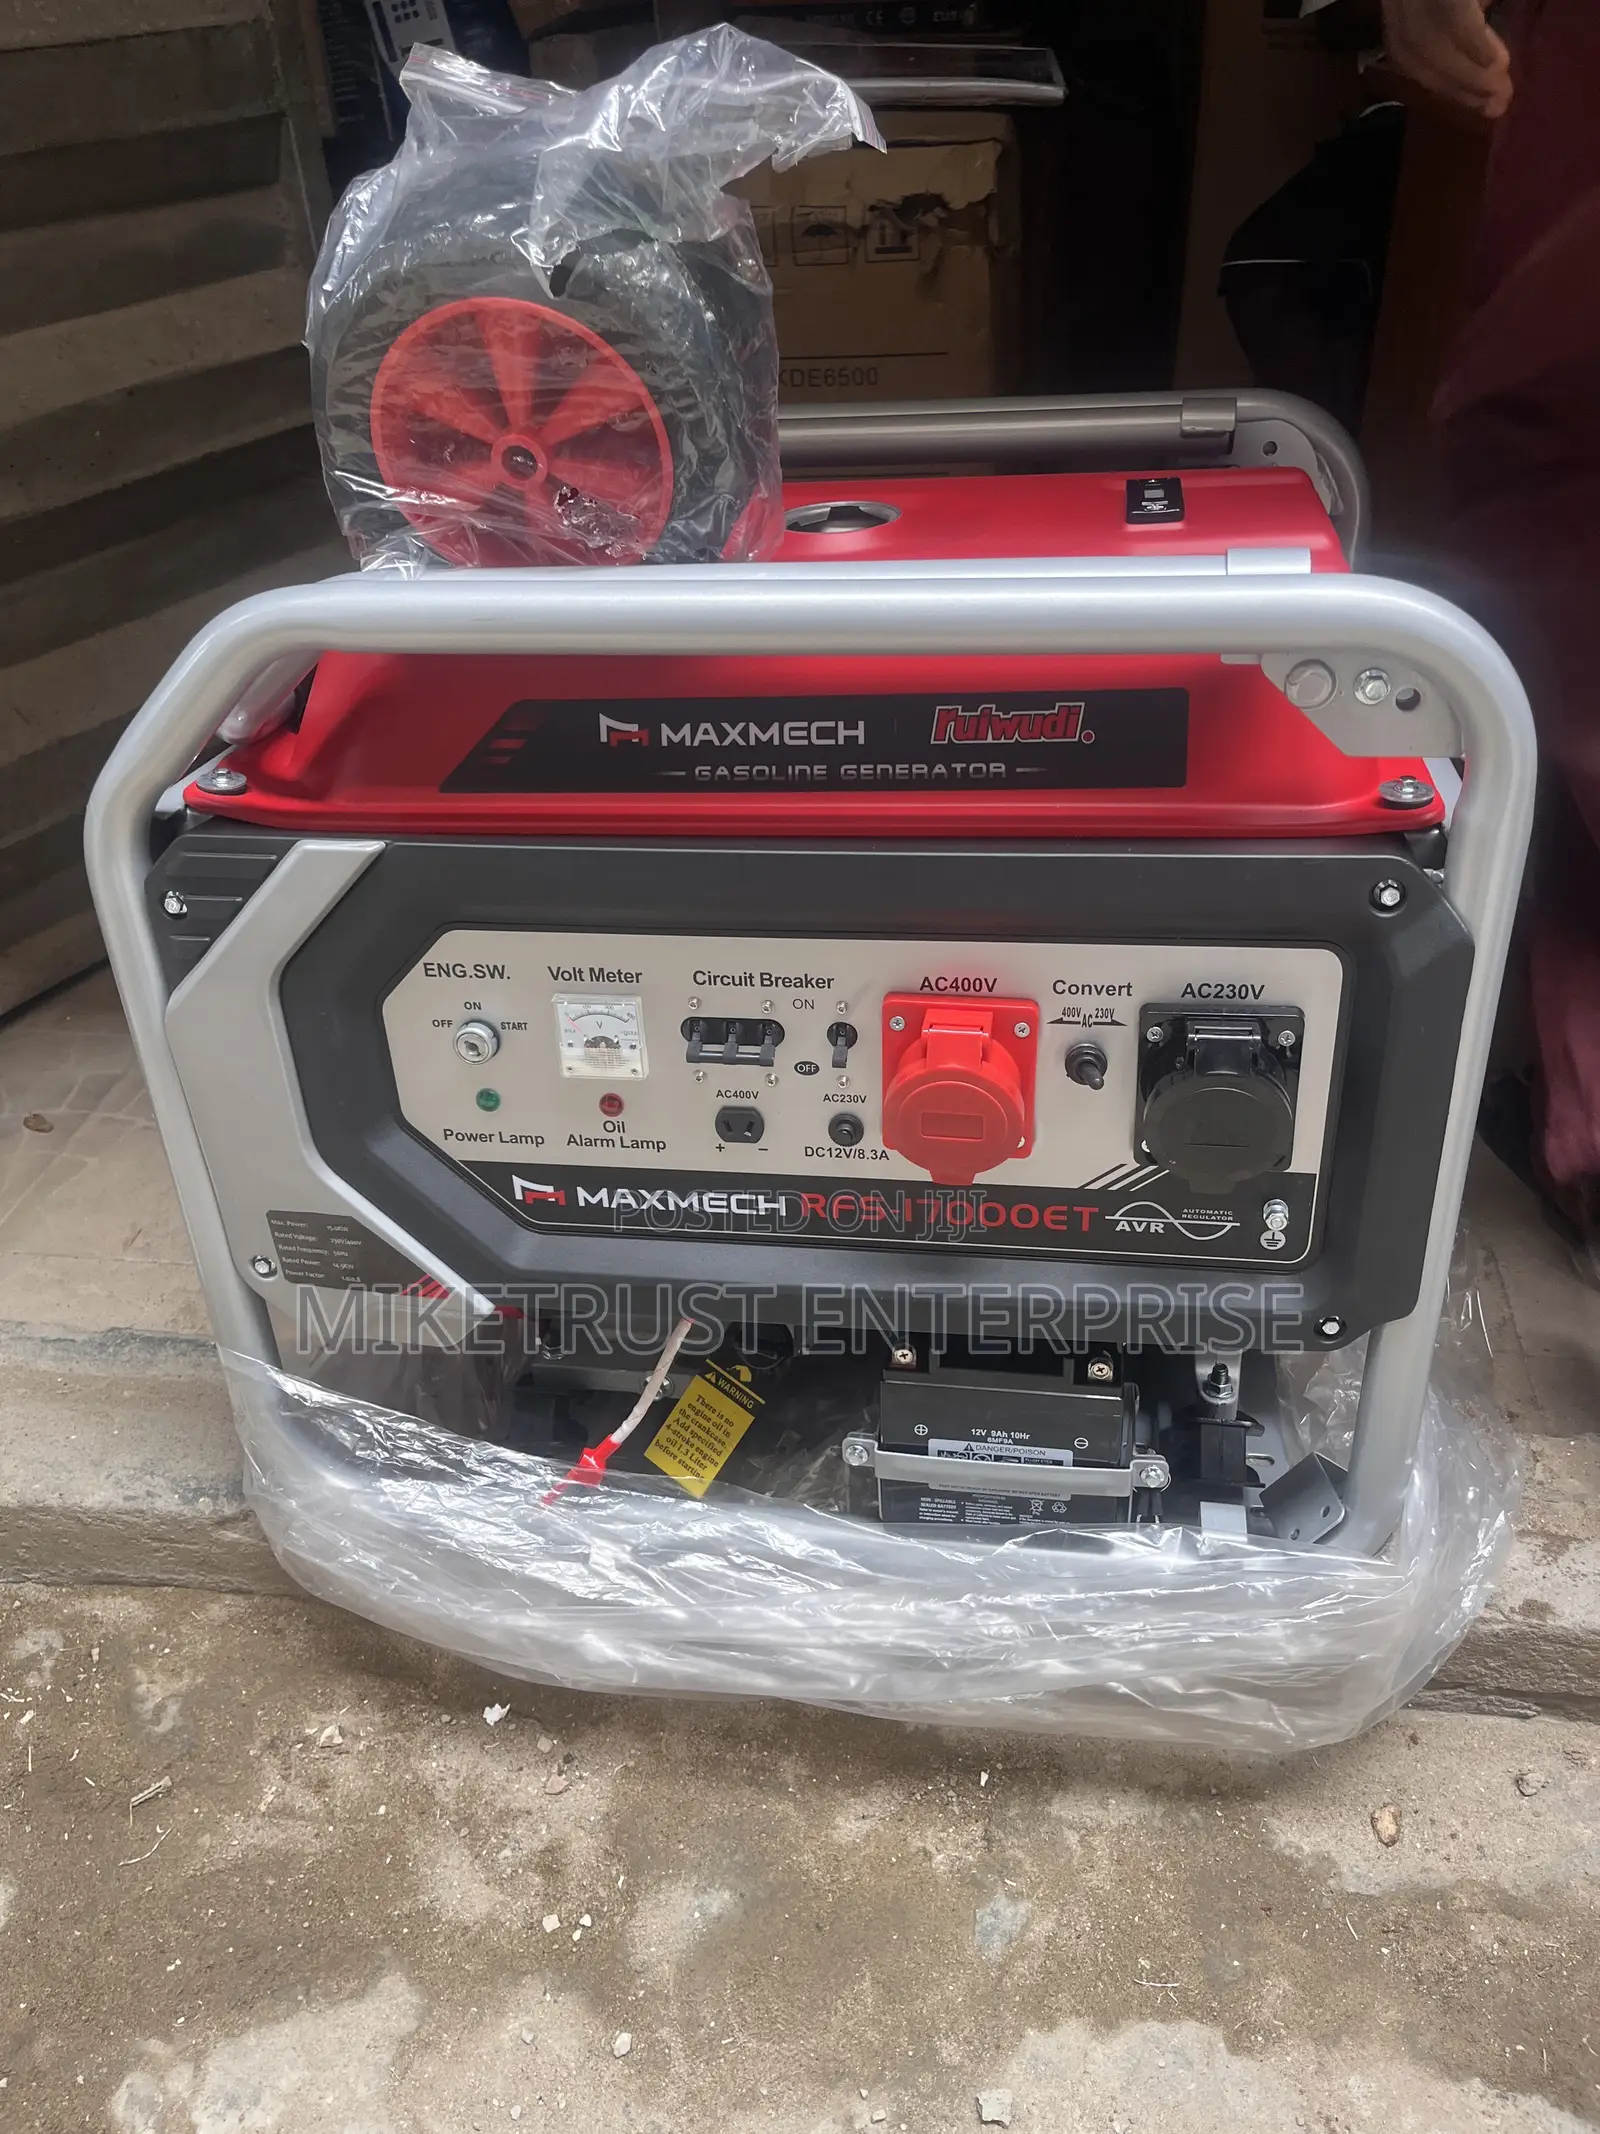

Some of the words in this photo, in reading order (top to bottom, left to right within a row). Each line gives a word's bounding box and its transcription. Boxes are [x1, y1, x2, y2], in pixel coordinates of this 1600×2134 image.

[660, 720, 865, 746] MAXMECH
[694, 763, 828, 781] GASOLINE
[840, 762, 1007, 780] GENERATOR
[423, 962, 511, 980] ENG.SW.
[547, 966, 585, 982] Volt
[589, 967, 643, 984] Meter
[692, 970, 755, 988] Circuit
[759, 972, 835, 990] Breaker
[919, 976, 998, 994] AC400V
[1052, 979, 1133, 997] Convert
[1181, 982, 1265, 1000] AC230V
[464, 1001, 482, 1011] ON
[792, 999, 815, 1010] ON
[1061, 1007, 1082, 1018] 400V
[1095, 1008, 1115, 1019] 230V
[432, 1019, 453, 1029] OFF
[500, 1021, 528, 1031] START
[1081, 1014, 1093, 1028] AC
[796, 1063, 817, 1074] OFF
[716, 1089, 759, 1100] AC400V
[823, 1093, 867, 1104] AC230V
[603, 1120, 626, 1134] Oil
[443, 1128, 495, 1143] Power
[499, 1131, 545, 1148] Lamp
[566, 1134, 615, 1148] Alarm
[620, 1136, 667, 1152] Lamp
[804, 1146, 890, 1161] DC12V/8.3A
[576, 1186, 787, 1216] MAXMECH
[1182, 1208, 1233, 1216] AUTOMATIC
[1115, 1220, 1165, 1234] AVR
[717, 1376, 755, 1410] WARNING
[679, 1408, 691, 1420] the
[687, 1402, 712, 1424] engine
[712, 1420, 722, 1432] oil
[722, 1427, 731, 1438] in
[696, 1394, 717, 1414] There
[716, 1410, 724, 1420] is
[724, 1417, 734, 1428] no
[673, 1417, 690, 1432] Add
[690, 1429, 723, 1457] specified
[971, 1428, 988, 1437] 12V
[990, 1430, 1008, 1438] 9Ah
[1010, 1432, 1031, 1440] 10Hr
[654, 1439, 678, 1461] before
[665, 1423, 695, 1449] 4-stroke
[695, 1445, 719, 1468] engine
[665, 1437, 677, 1448] oil
[689, 1451, 708, 1471] Liter
[975, 1444, 1046, 1457] DANGER/POISON
